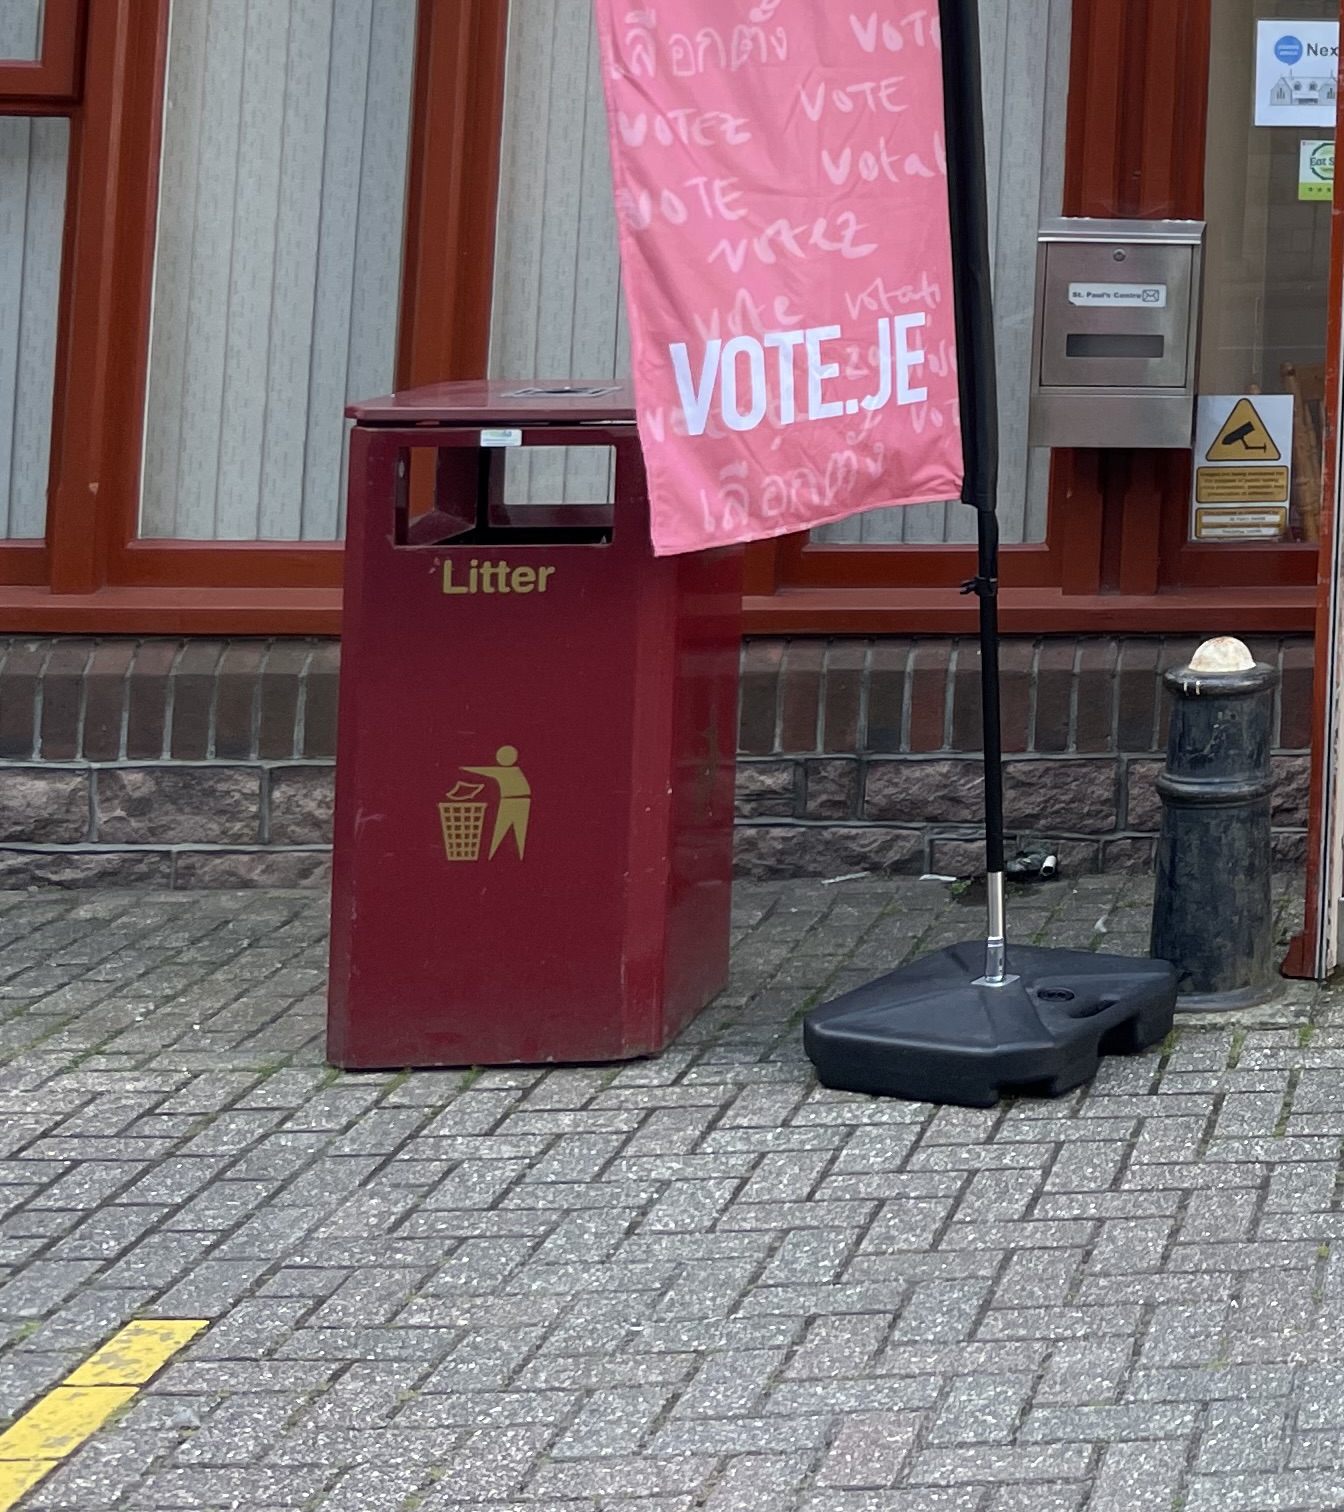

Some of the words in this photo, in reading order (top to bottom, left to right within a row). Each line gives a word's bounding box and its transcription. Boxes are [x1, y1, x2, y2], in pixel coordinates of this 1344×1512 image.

[1307, 42, 1339, 57] Nex
[668, 311, 928, 436] VOTE.JE
[443, 559, 556, 594] Litter
